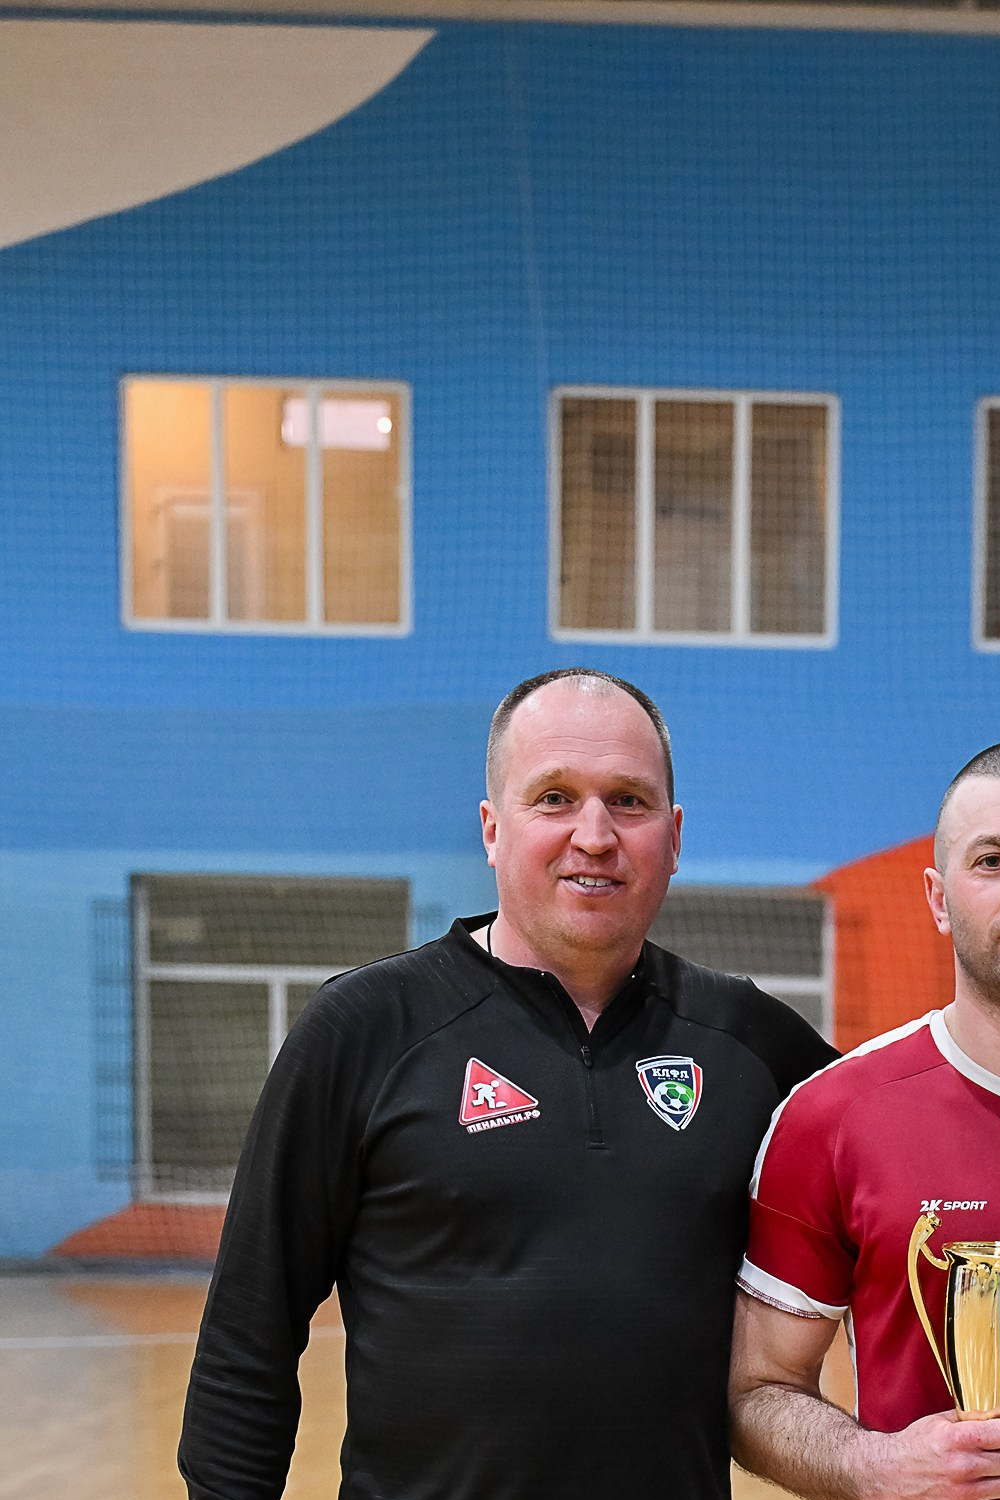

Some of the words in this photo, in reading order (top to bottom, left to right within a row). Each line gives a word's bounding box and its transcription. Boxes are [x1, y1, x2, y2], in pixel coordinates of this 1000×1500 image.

[652, 1068, 689, 1079] КЛФЛ
[466, 1110, 541, 1134] ПЕНАЛЬТИ.РФ
[920, 1199, 943, 1212] 2K
[943, 1201, 988, 1211] SPORT
